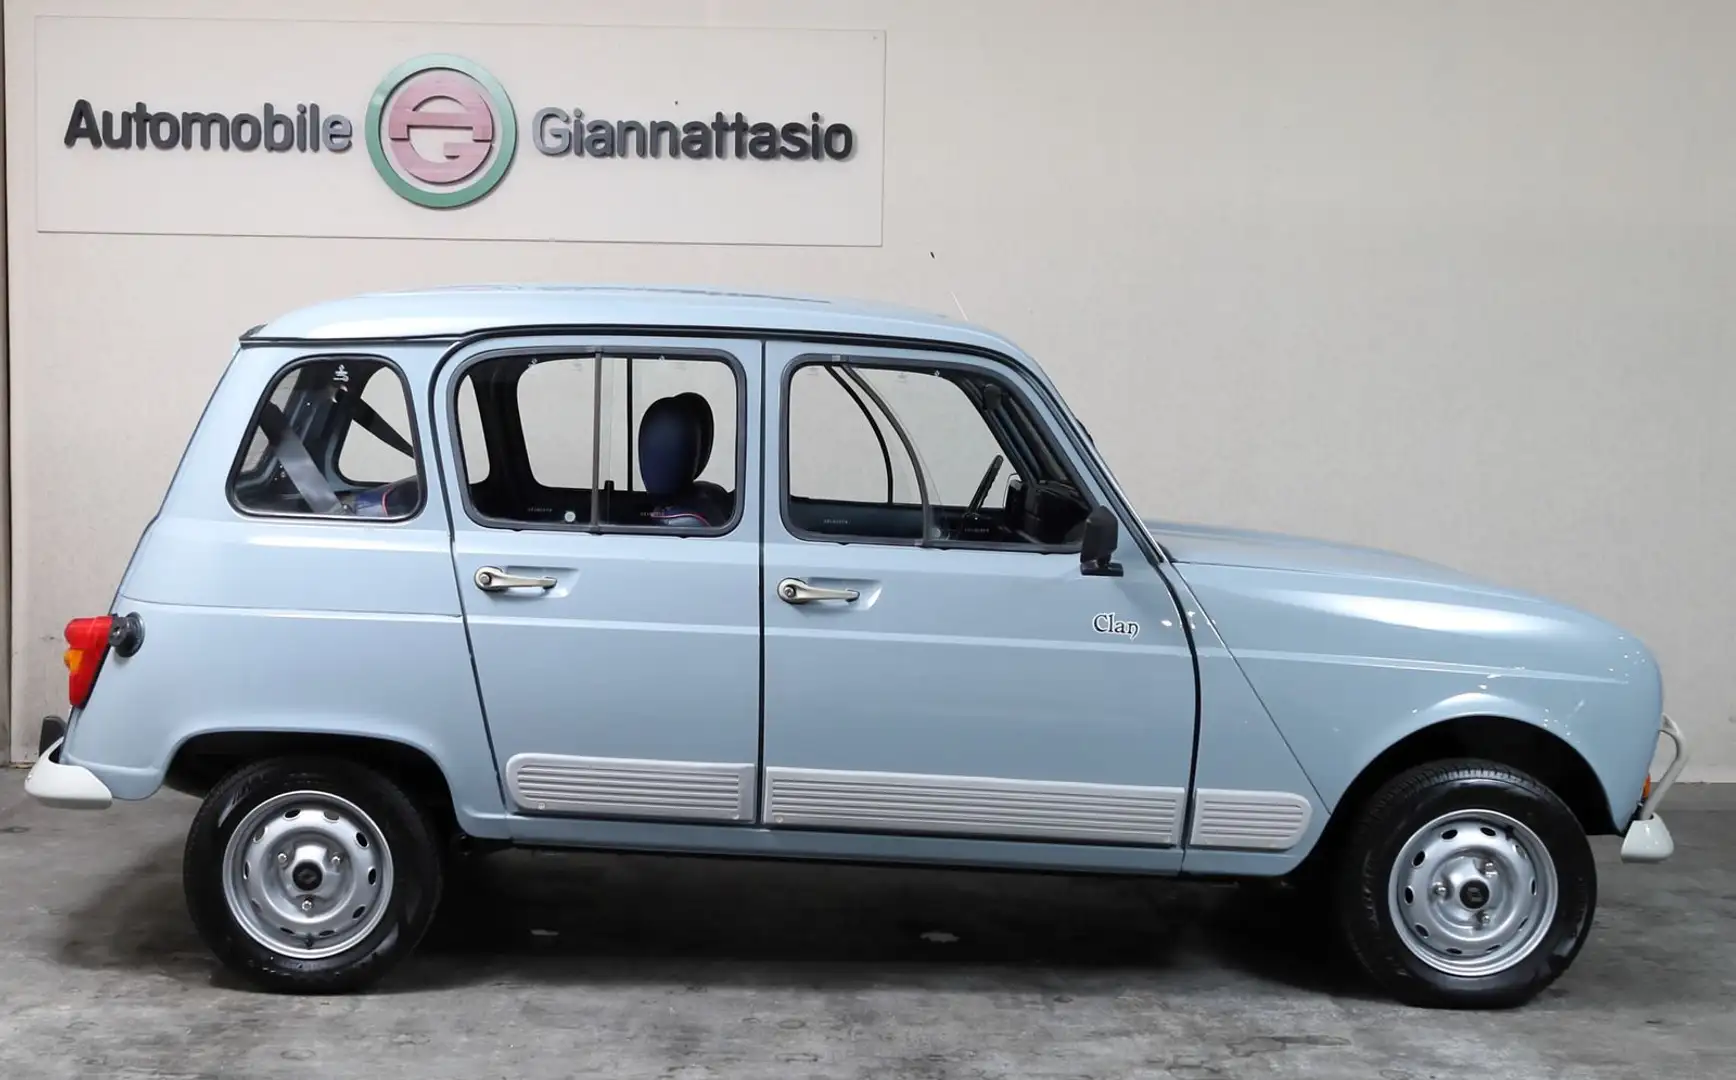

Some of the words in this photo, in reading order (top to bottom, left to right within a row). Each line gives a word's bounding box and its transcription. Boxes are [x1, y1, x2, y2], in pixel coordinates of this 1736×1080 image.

[64, 99, 352, 153] Automobile
[532, 107, 854, 160] Giannattasio
[1092, 612, 1140, 640] Clan
